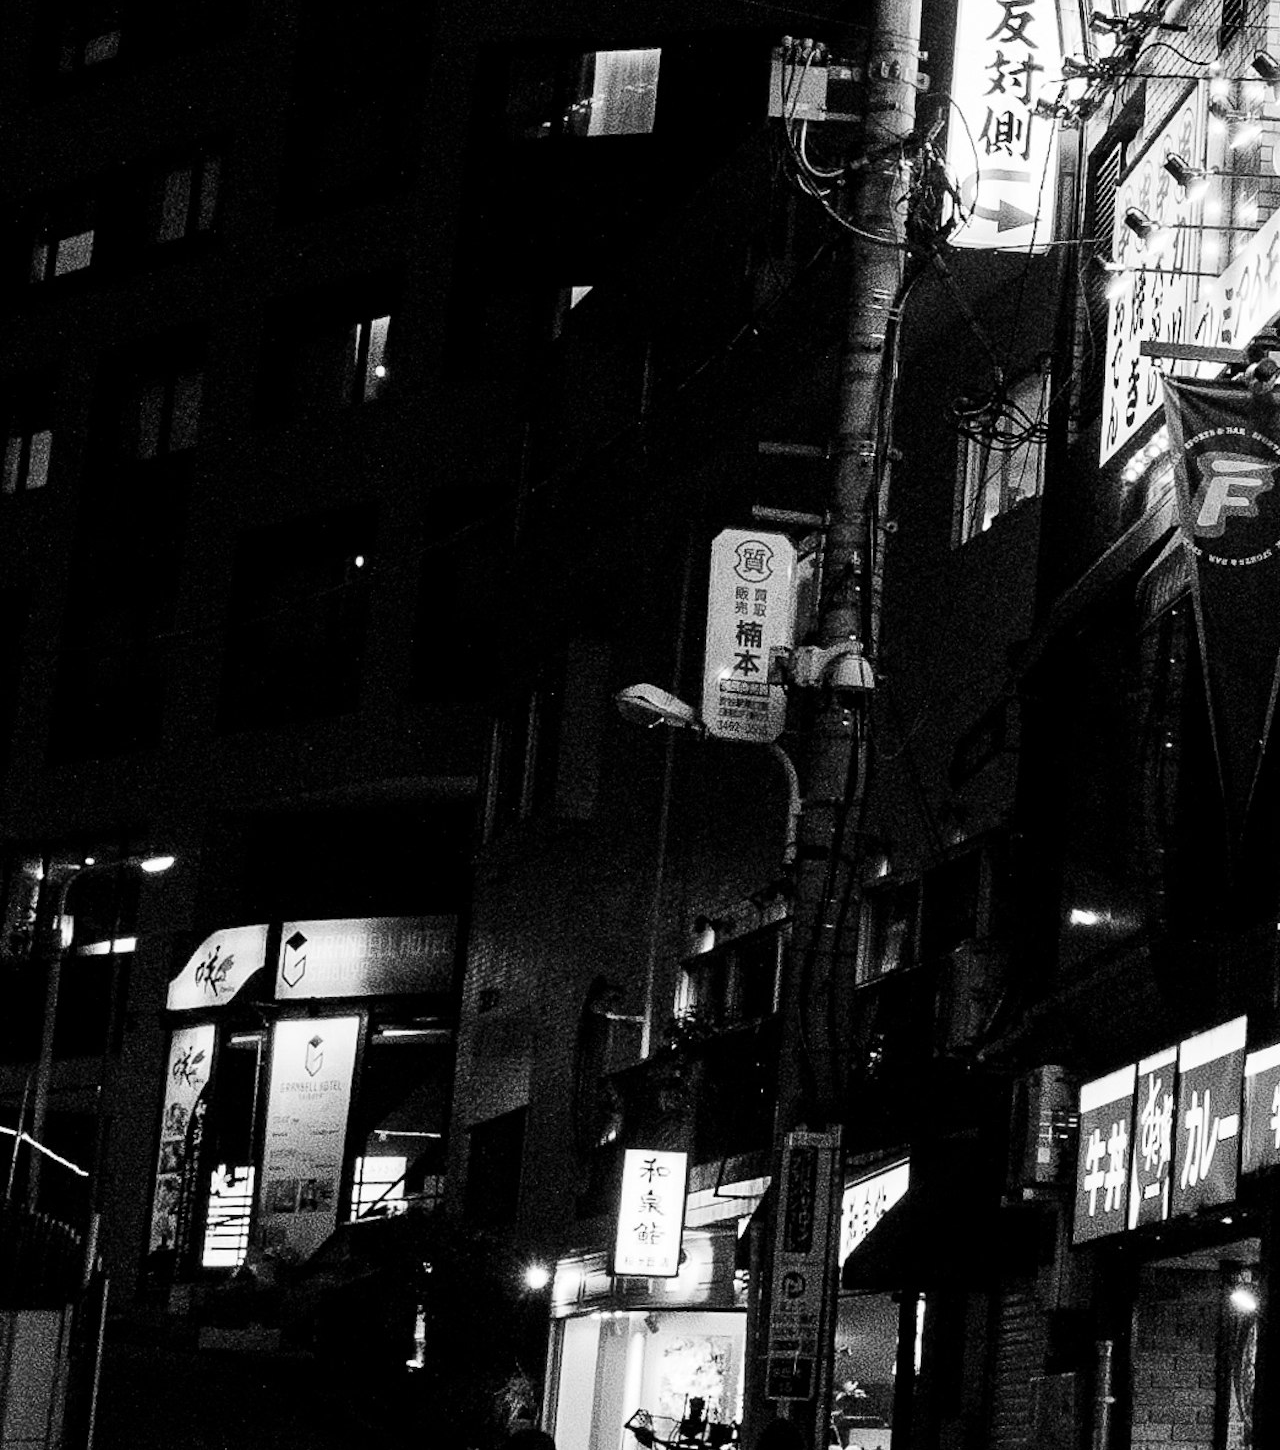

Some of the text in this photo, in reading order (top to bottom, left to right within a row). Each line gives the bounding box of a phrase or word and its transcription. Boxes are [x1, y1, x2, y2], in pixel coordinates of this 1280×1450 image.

[742, 548, 766, 574] 質
[734, 619, 763, 677] 楠本
[1083, 1118, 1127, 1218] 牛丼
[1140, 1073, 1173, 1178] すき家
[1181, 1089, 1240, 1191] カレー
